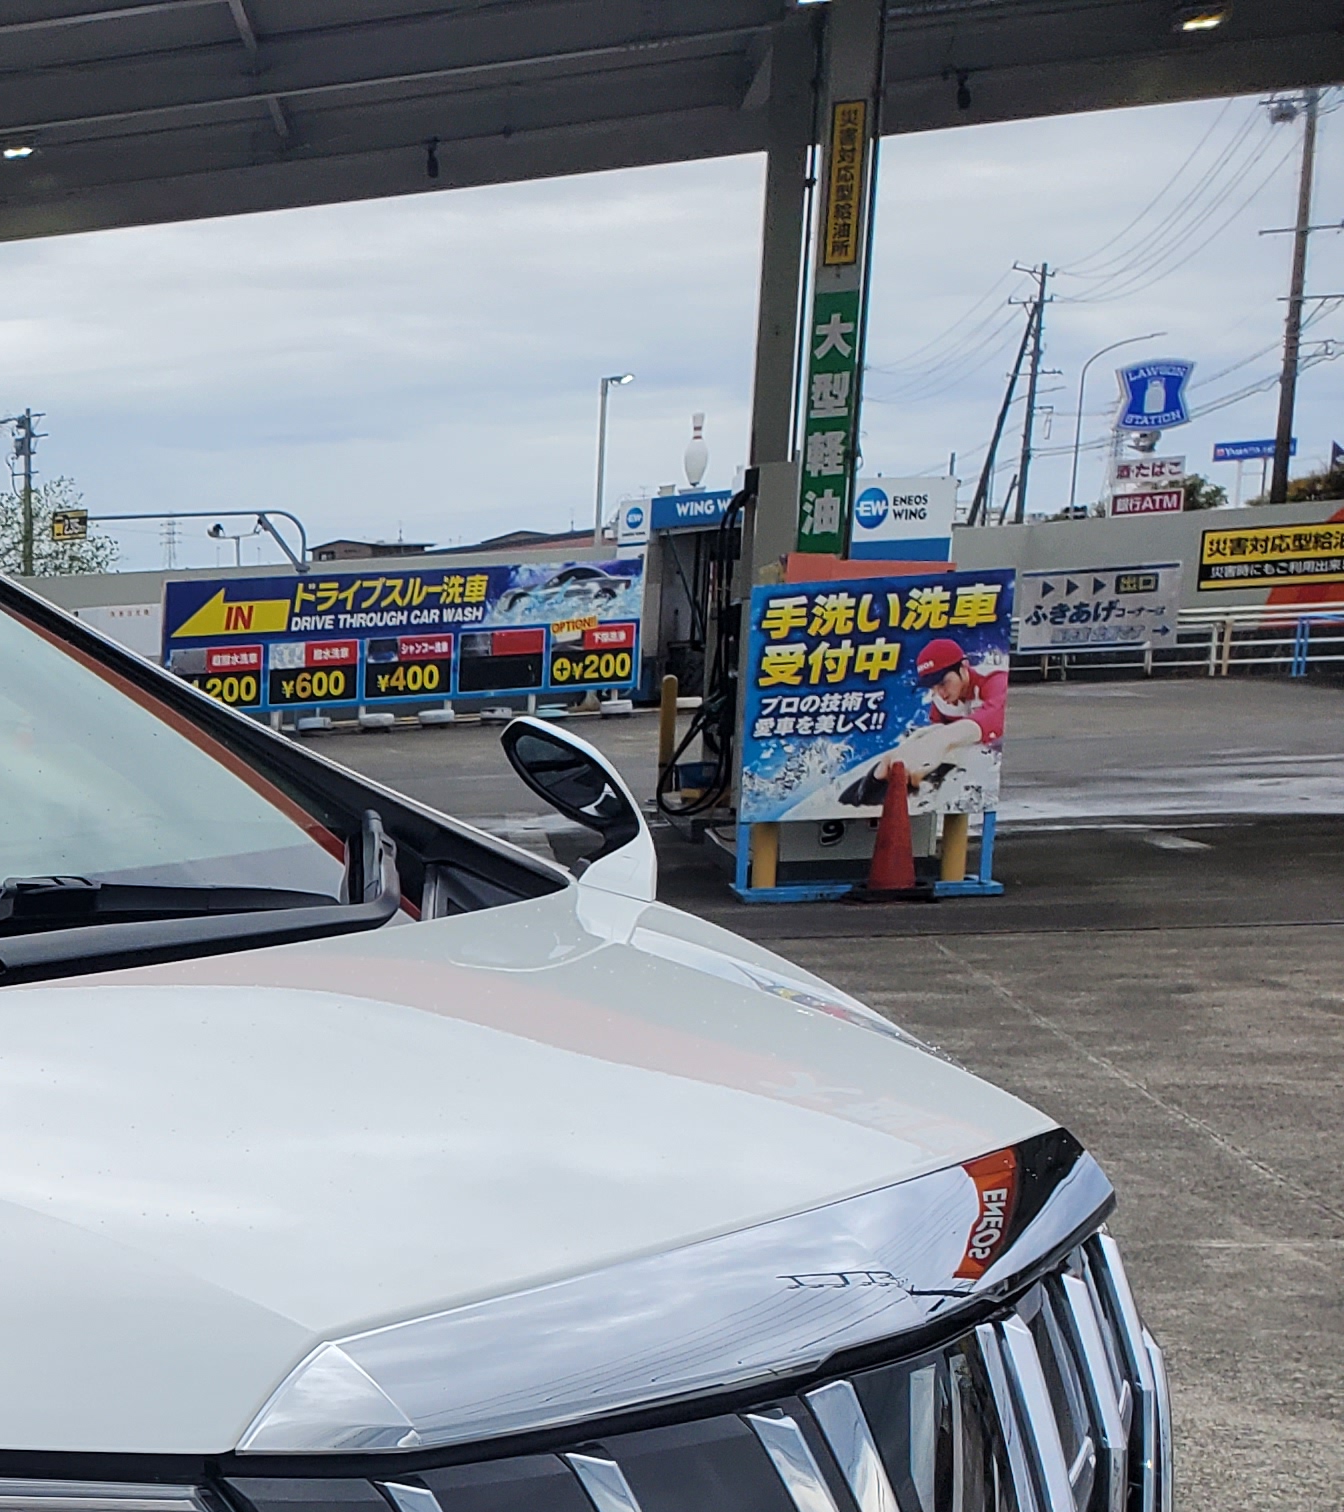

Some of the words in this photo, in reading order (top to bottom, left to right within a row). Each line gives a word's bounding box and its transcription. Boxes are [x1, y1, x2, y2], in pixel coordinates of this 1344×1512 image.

[801, 313, 854, 535] 大型軽油
[1124, 409, 1182, 425] STATION
[676, 499, 715, 517] WING
[892, 494, 929, 507] ENEOS
[1115, 494, 1178, 512] 銀行ATM
[892, 508, 928, 521] WING
[1210, 559, 1344, 578] 災害時にもご利用出来
[294, 574, 488, 613] ドライブスルー洗車
[1119, 575, 1156, 592] 出口
[225, 606, 253, 630] IN
[291, 616, 334, 631] DRIVE
[337, 611, 408, 629] THROUGH
[410, 609, 441, 624] CAR
[443, 606, 484, 623] WASH
[761, 583, 1002, 639] 手洗い洗車
[758, 638, 901, 686] 受付中
[281, 670, 345, 699] ¥600
[376, 664, 440, 693] ¥400
[762, 691, 885, 715] プロの技術で
[753, 713, 885, 738] 愛車を美しく!!
[820, 821, 845, 846] 9
